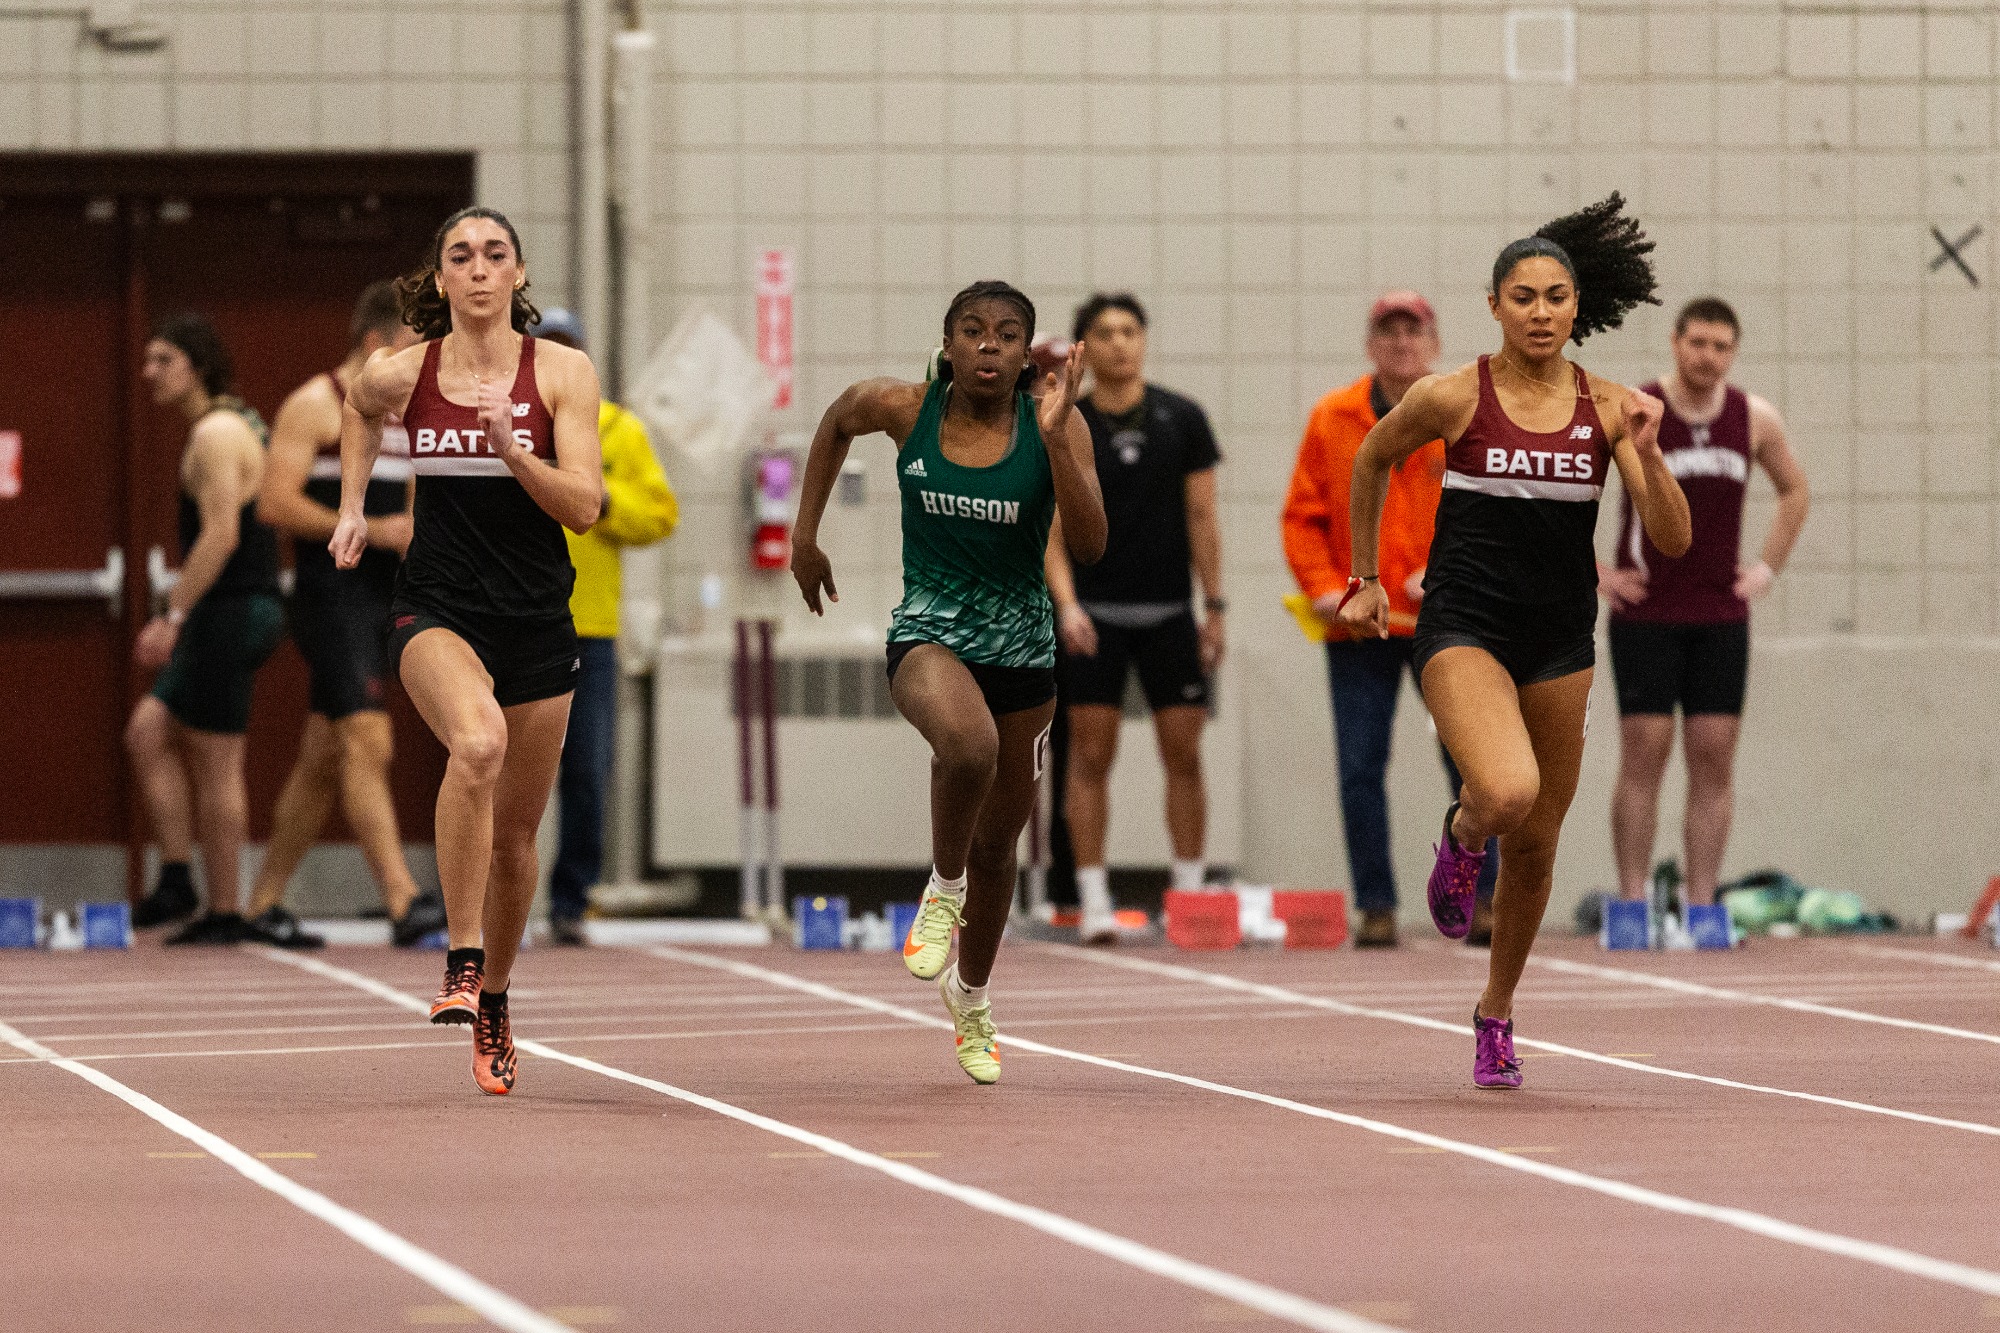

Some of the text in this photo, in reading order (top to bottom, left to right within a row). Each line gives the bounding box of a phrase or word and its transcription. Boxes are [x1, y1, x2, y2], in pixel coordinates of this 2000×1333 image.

[416, 428, 534, 453] BATS
[904, 468, 928, 477] adidas
[1486, 448, 1593, 480] BATES
[920, 490, 1020, 524] HUSSON
